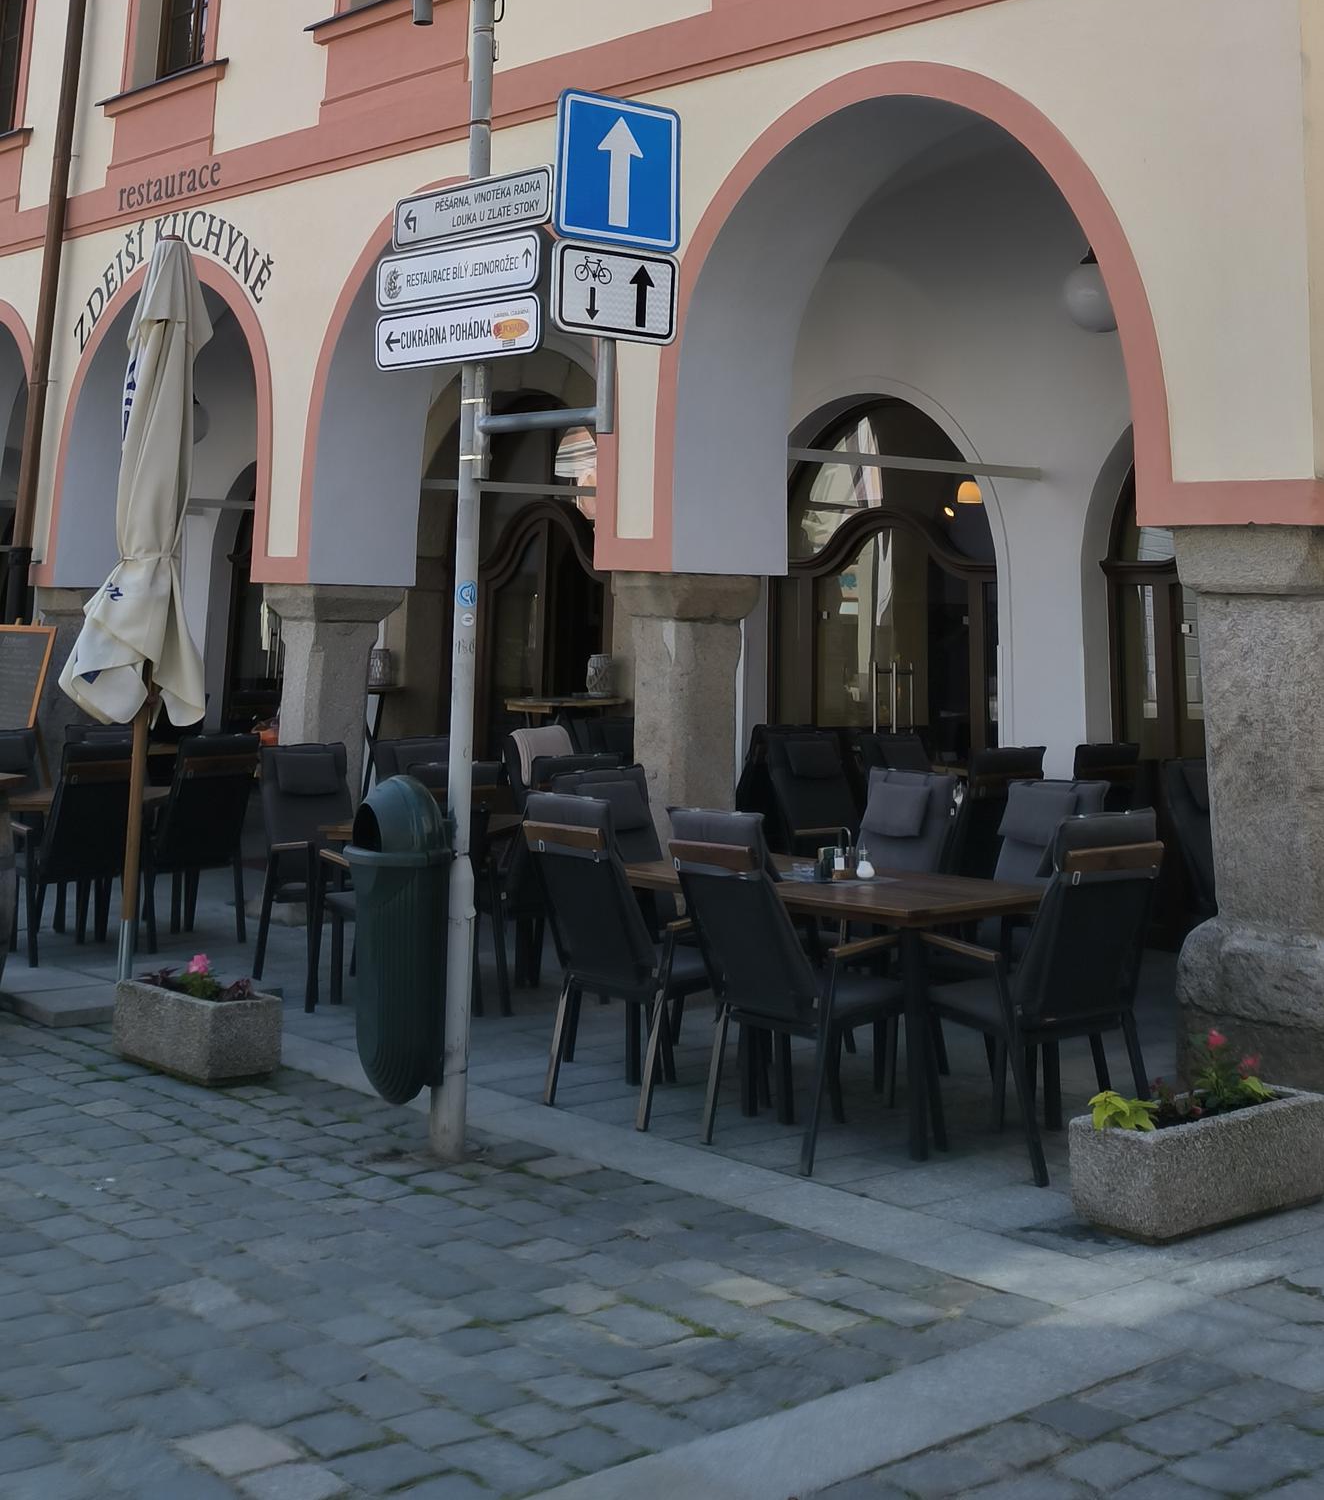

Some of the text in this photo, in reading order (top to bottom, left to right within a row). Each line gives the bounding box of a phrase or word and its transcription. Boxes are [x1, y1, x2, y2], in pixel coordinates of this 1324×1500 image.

[118, 161, 221, 211] restaurace
[513, 180, 541, 196] RADKA
[452, 211, 477, 227] LOUKA
[479, 210, 485, 222] U
[514, 199, 540, 215] STOKY
[73, 210, 276, 355] ZDEJŠÍ KUCHYNĚ
[406, 252, 519, 287] RESTAURACE BÍLÝ JEDNOROŽEC
[400, 323, 447, 350] CUKRÁRNA
[450, 316, 492, 342] POHÁDKA
